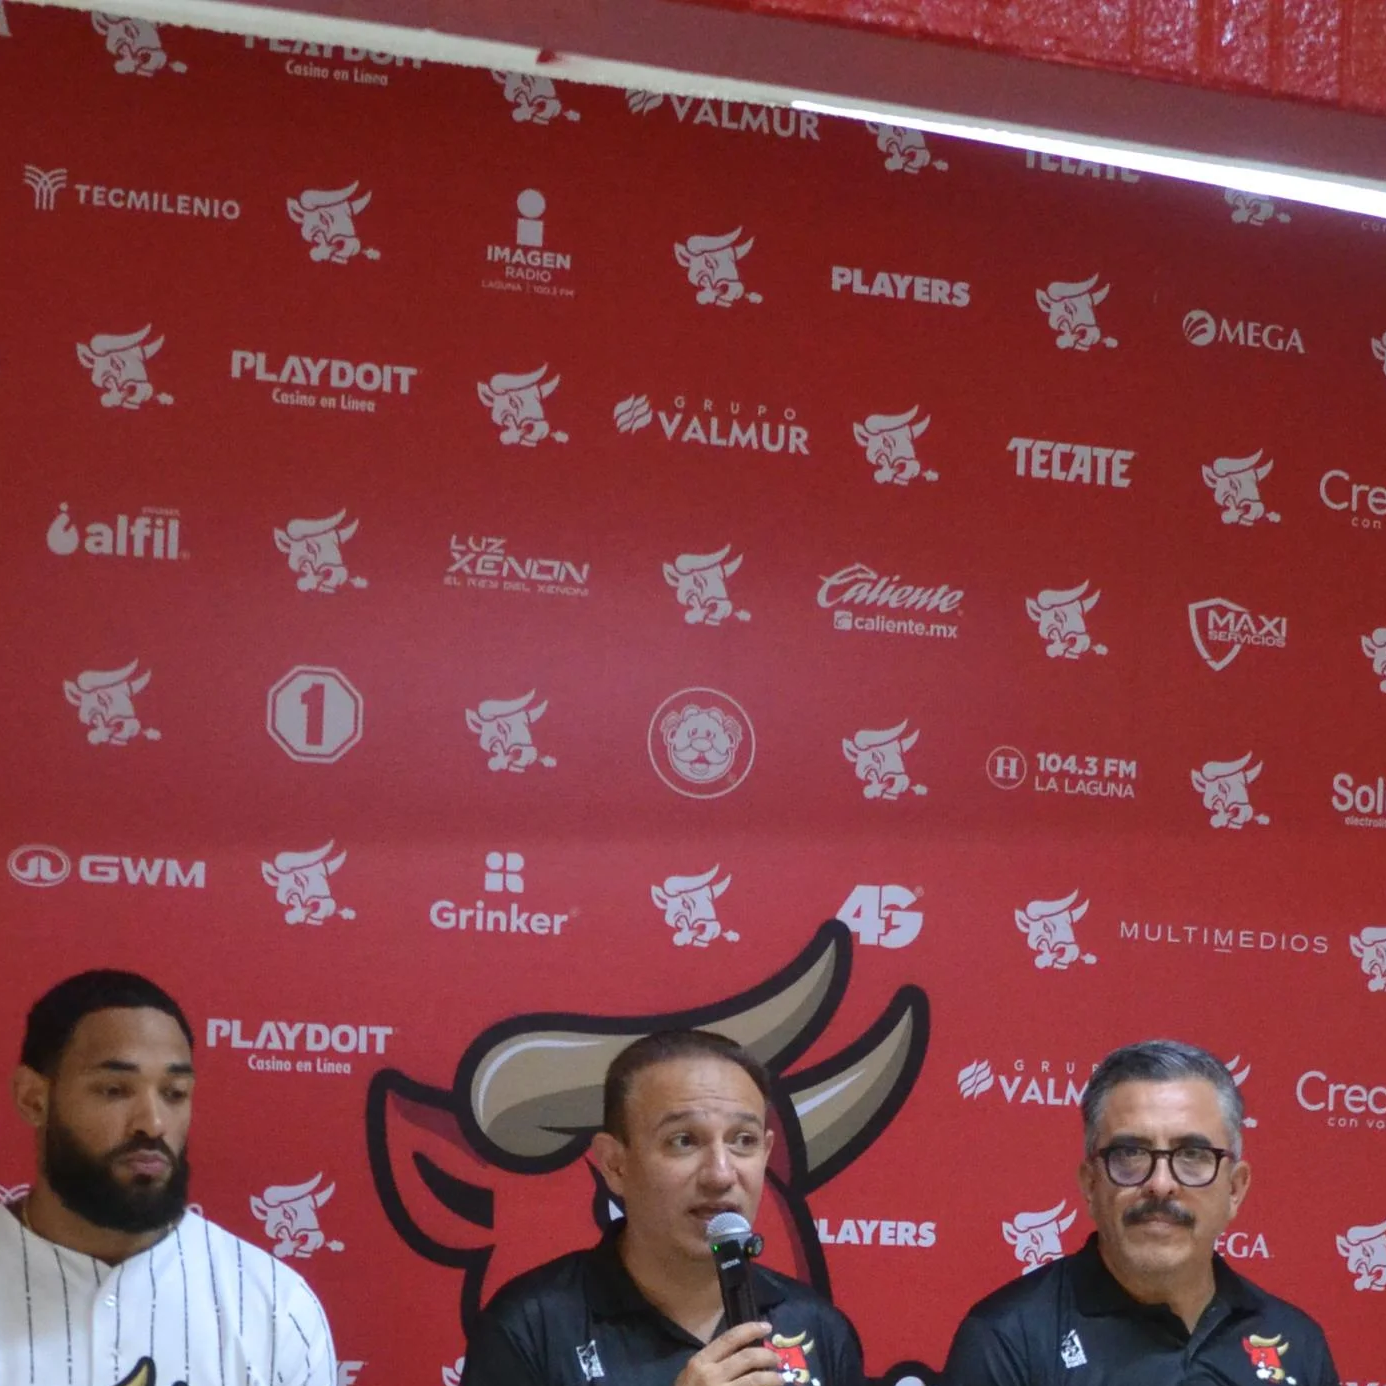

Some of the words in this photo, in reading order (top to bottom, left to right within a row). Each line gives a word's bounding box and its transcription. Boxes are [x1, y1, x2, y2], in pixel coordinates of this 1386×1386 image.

[285, 57, 330, 82] Casino
[333, 66, 351, 83] en
[670, 95, 820, 141] VALMUR
[75, 183, 241, 221] TECMILENIO
[486, 244, 572, 271] IMAGEN
[505, 265, 553, 284] RADIO
[832, 265, 971, 308] PLAYERS
[1218, 317, 1307, 354] MEGA
[231, 350, 418, 396] PLAYDOIT
[272, 388, 317, 408] Casino
[319, 394, 338, 409] en
[673, 396, 798, 422] GRUPO
[657, 410, 810, 457] VALMUR
[1007, 437, 1137, 488] TECATE
[84, 513, 181, 561] alfil
[1351, 515, 1383, 532] con
[450, 532, 507, 554] LUZ
[447, 550, 591, 586] XENON
[817, 562, 965, 614] Caliente
[854, 614, 958, 639] caliente.mx
[1208, 609, 1288, 639] MAXI
[1208, 631, 1286, 648] SERVICIOS
[1036, 752, 1099, 779] 104.3
[1104, 758, 1138, 781] FM
[1035, 774, 1060, 793] LA
[1065, 778, 1136, 799] LAGUNA
[79, 854, 206, 888] GWM
[429, 900, 569, 936] Grinker
[1119, 920, 1329, 954] MULTIMEDIOS
[206, 1017, 394, 1055] PLAYDOIT
[247, 1053, 293, 1072] Casino
[296, 1058, 313, 1073] en
[315, 1055, 352, 1075] Línea
[1326, 1116, 1358, 1130] con
[816, 1220, 937, 1247] LAYERS
